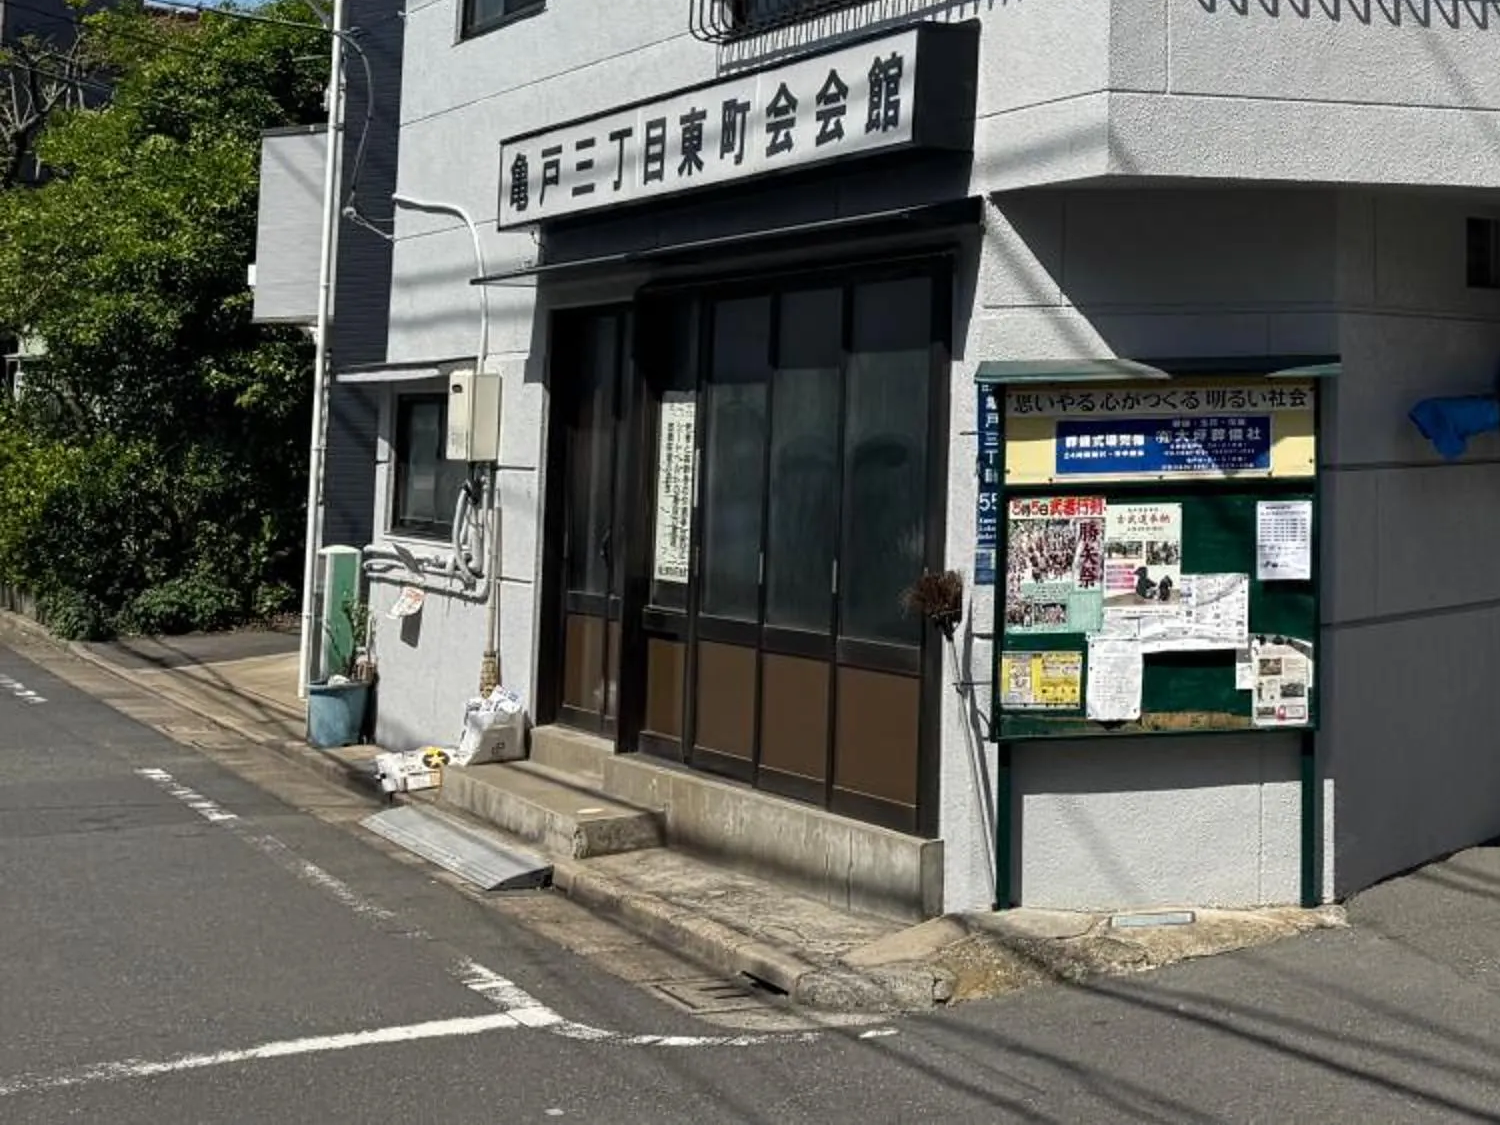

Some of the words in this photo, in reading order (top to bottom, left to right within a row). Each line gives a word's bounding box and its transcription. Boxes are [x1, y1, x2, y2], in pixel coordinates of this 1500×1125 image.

[508, 51, 904, 213] 亀戸三丁目東町会会館
